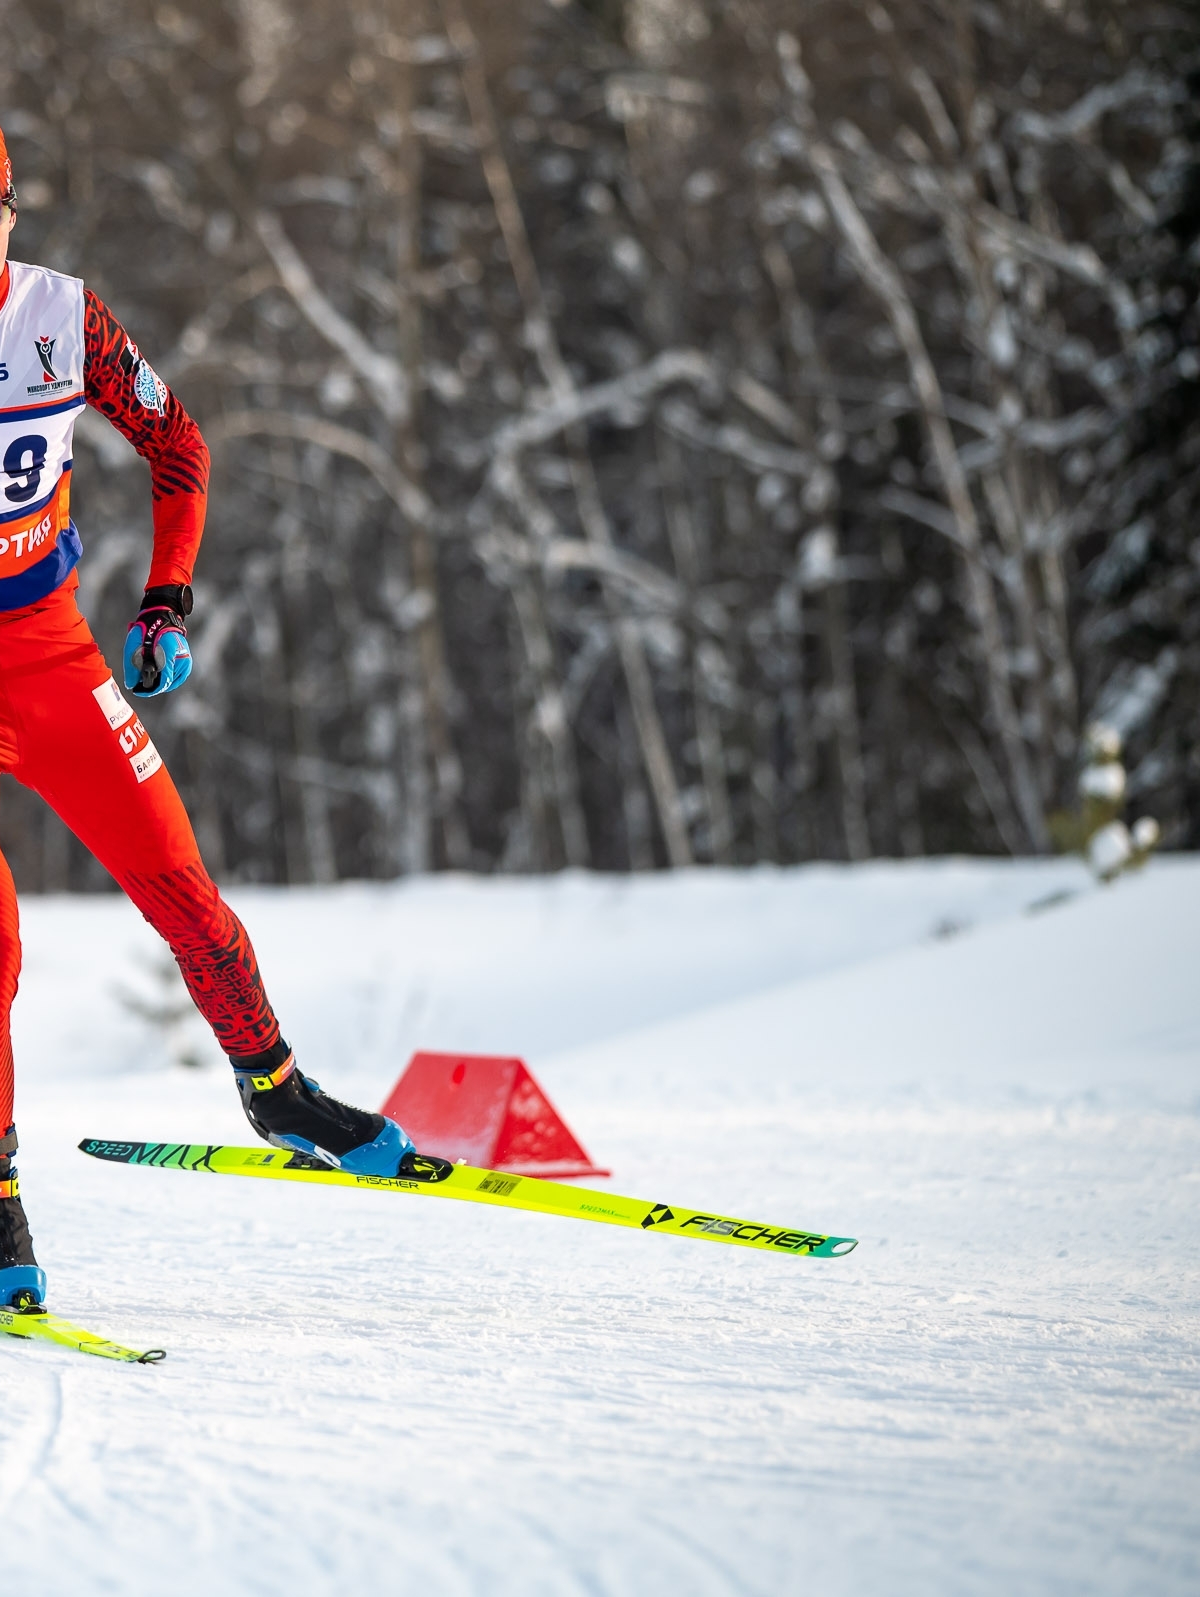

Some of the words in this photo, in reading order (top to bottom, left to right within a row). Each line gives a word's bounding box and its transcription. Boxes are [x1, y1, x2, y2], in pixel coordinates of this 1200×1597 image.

[85, 1140, 133, 1156] SPEED
[356, 1175, 419, 1190] FISCHER
[680, 1215, 826, 1253] FISCHER
